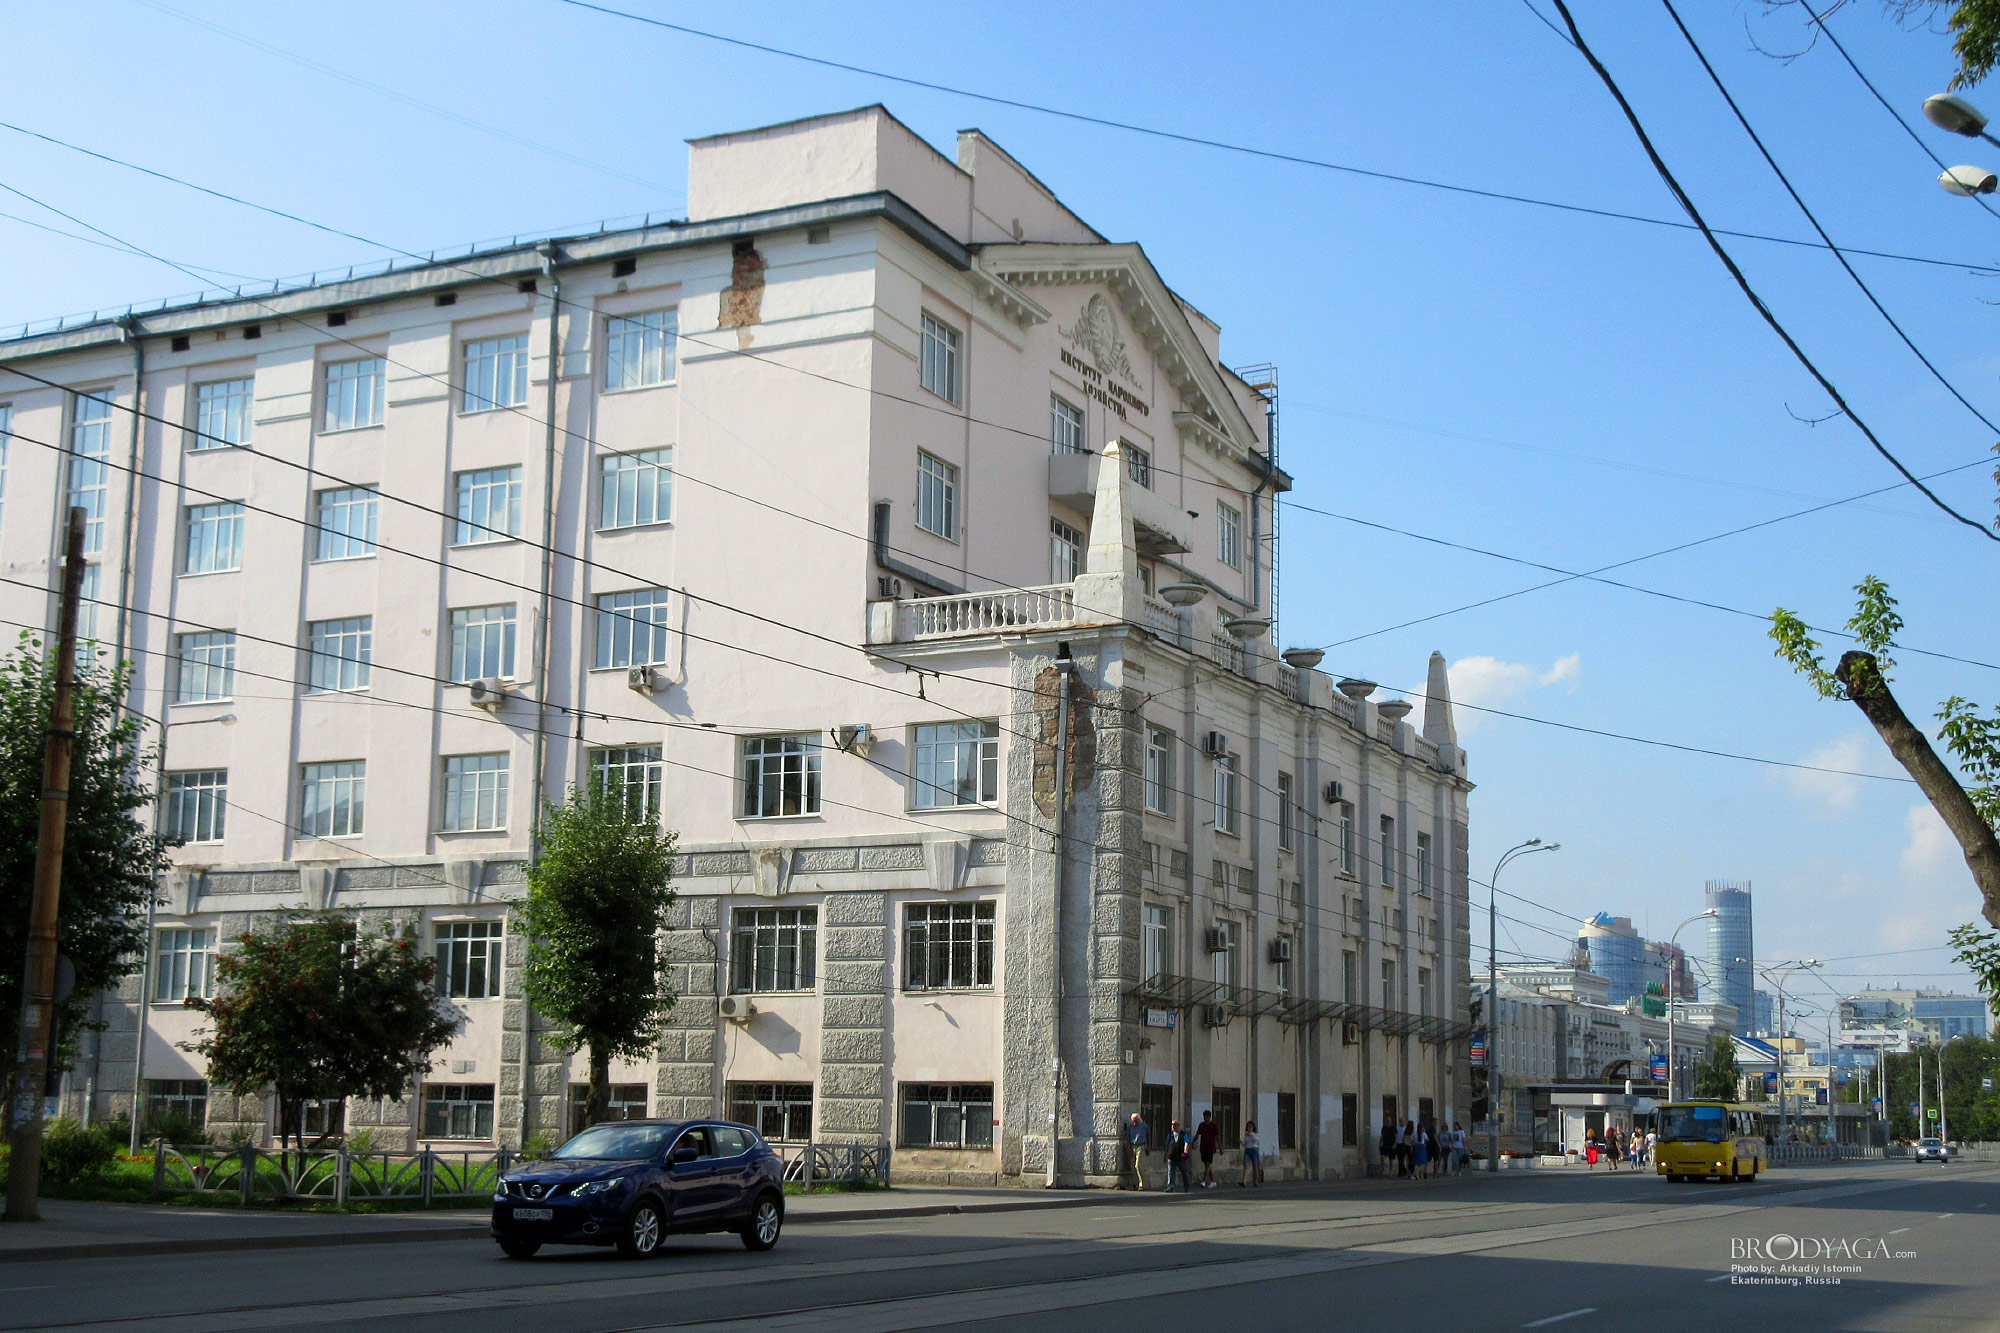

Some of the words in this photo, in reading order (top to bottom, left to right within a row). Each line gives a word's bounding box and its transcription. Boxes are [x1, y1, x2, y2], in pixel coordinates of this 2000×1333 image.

[1060, 347, 1102, 385] ИНСТИТУТ
[1108, 379, 1150, 417] НАРОДНОГО
[1082, 380, 1127, 420] ХОЗЯЙСТВА
